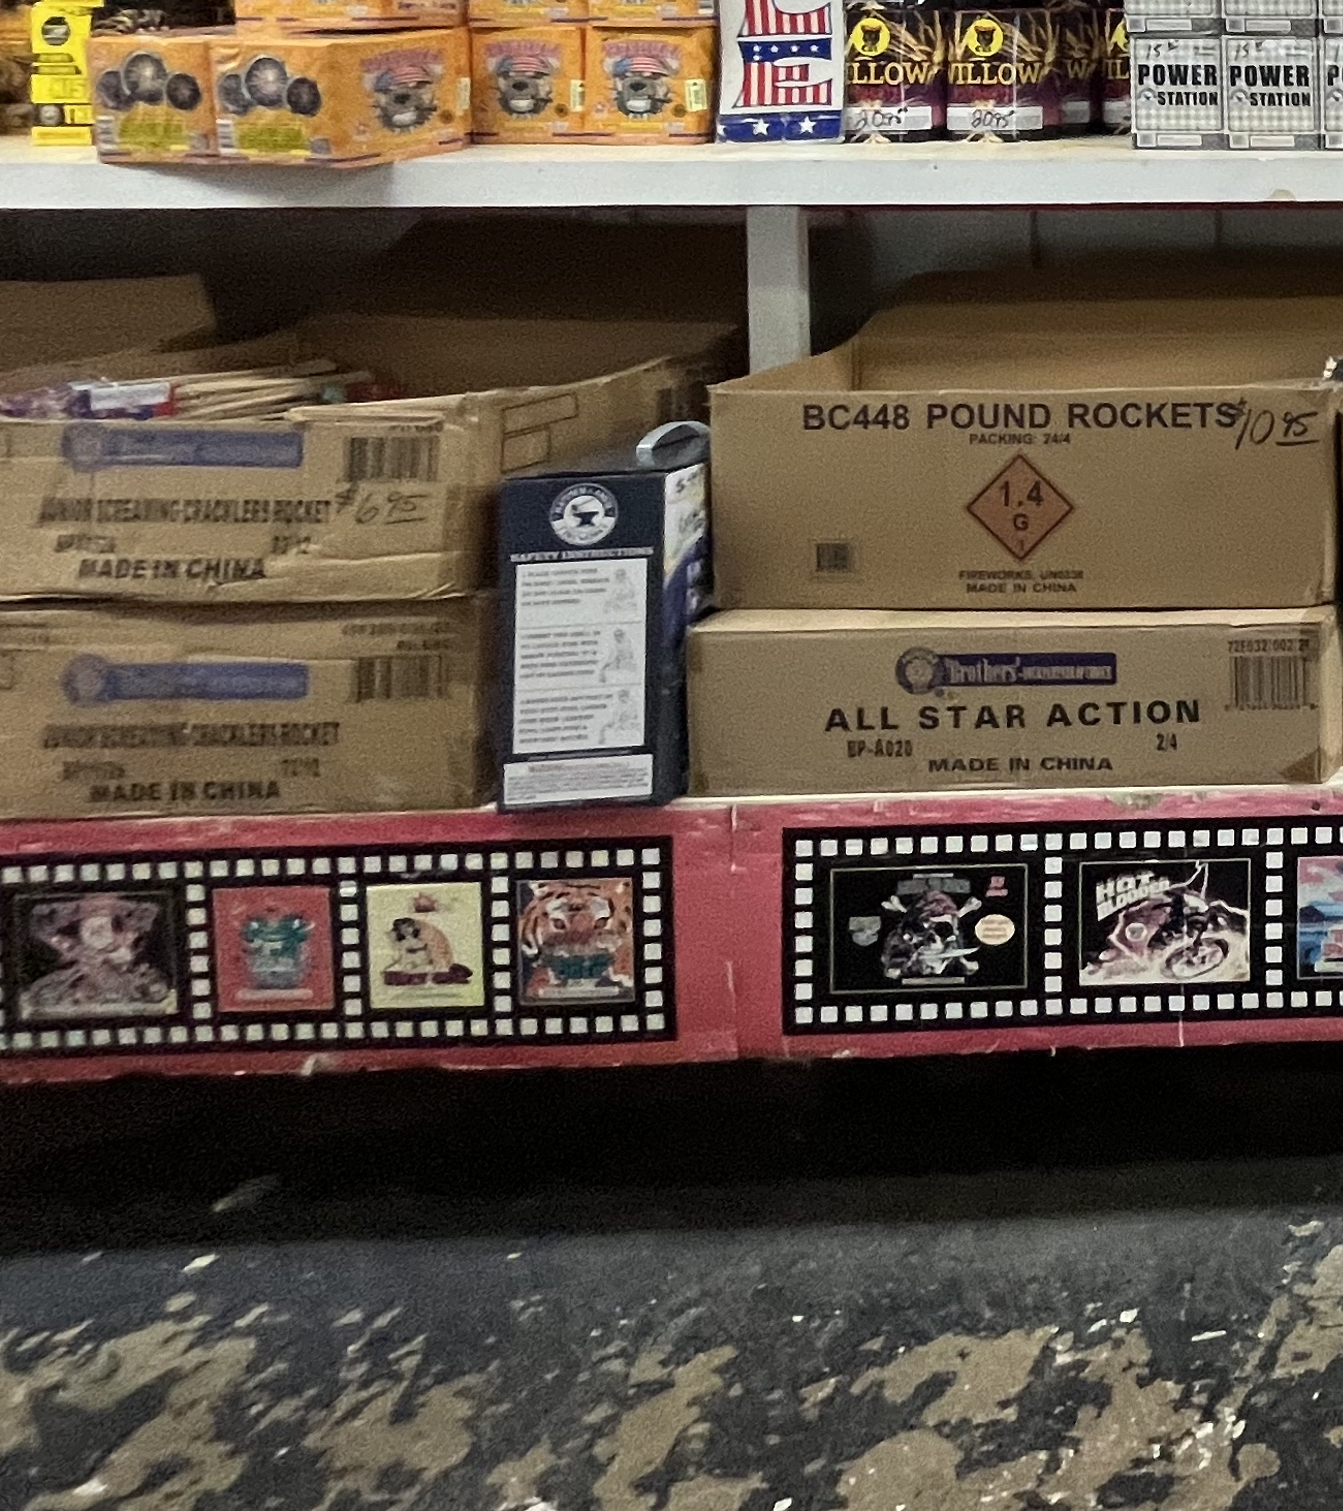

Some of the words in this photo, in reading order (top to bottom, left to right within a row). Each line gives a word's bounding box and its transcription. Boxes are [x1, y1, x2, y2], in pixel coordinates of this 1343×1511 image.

[1138, 64, 1217, 87] POWER
[1157, 91, 1217, 106] STATION
[804, 403, 909, 431] BC448
[928, 403, 1051, 430] POUND
[1068, 402, 1237, 430] ROCKETS
[825, 705, 903, 734] ALL
[920, 703, 1026, 731] STAR
[1047, 699, 1201, 727] ACTION
[928, 758, 1002, 773] MADE
[1009, 757, 1032, 772] IN
[1039, 756, 1114, 772] CHINA
[204, 780, 280, 800] CHINA
